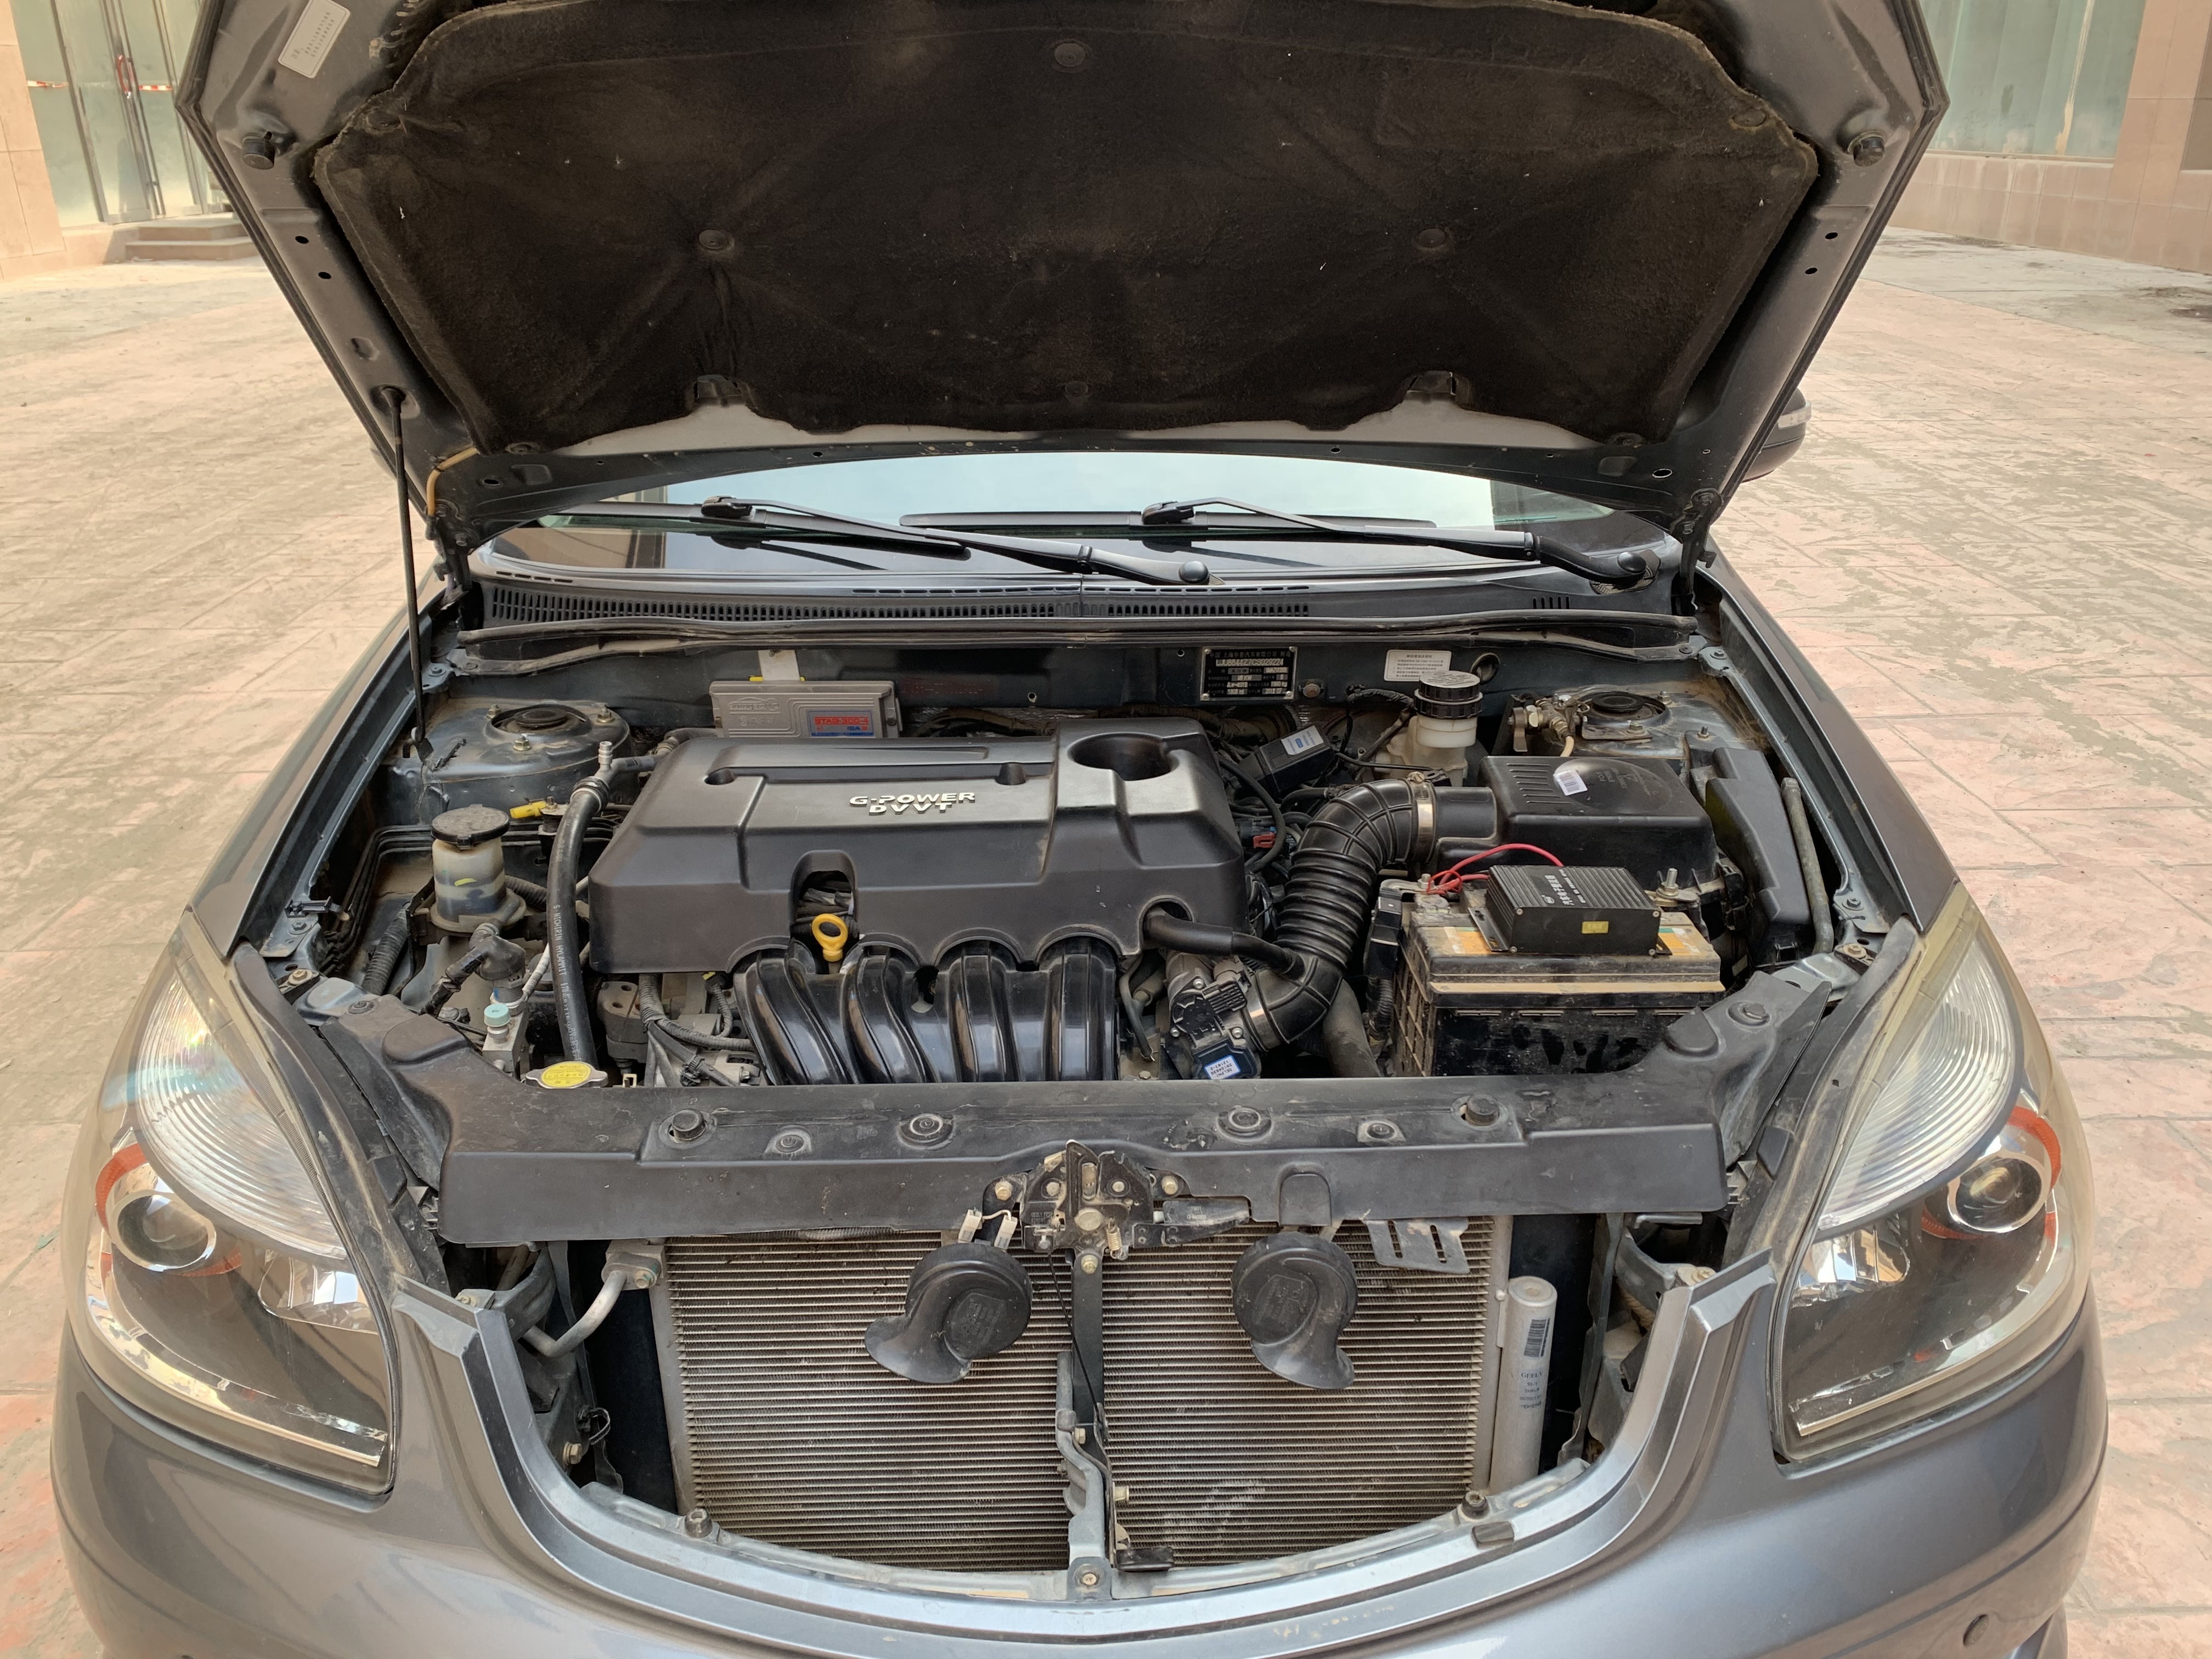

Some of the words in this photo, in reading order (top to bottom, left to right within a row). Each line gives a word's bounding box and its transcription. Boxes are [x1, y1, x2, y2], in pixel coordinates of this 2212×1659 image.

[849, 792, 975, 806] G-POWER
[869, 803, 952, 815] DVVT
[1216, 1068, 1232, 1077] DELPHI
